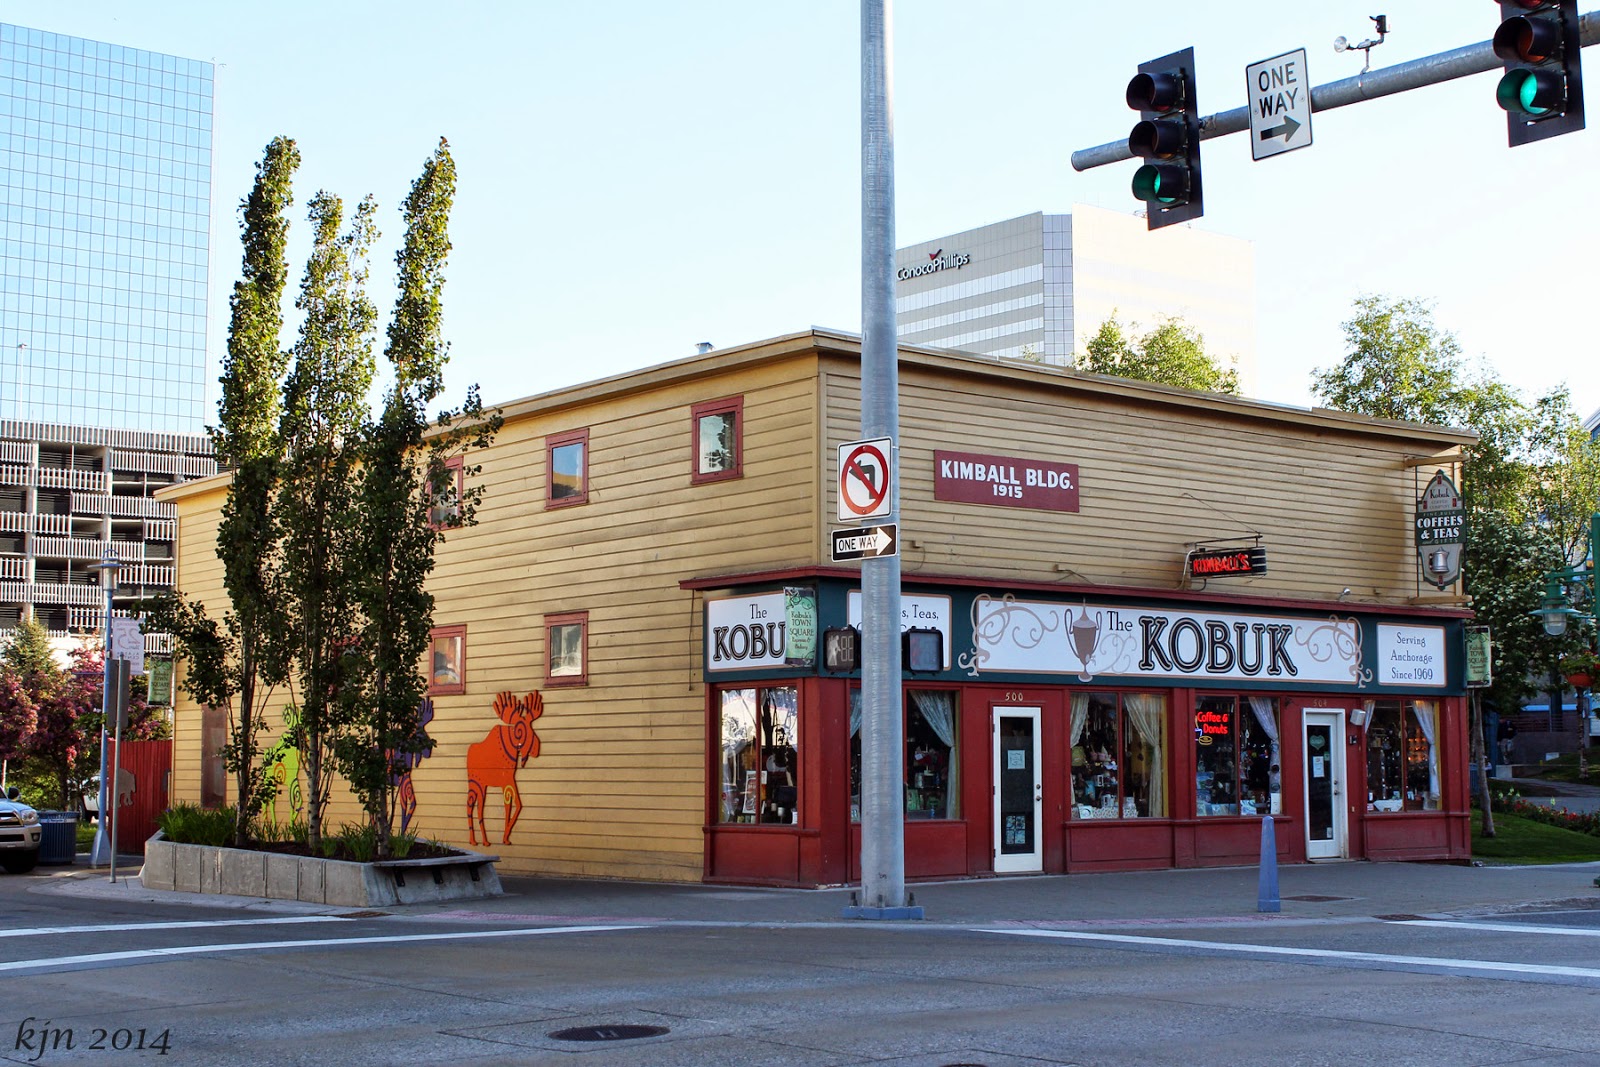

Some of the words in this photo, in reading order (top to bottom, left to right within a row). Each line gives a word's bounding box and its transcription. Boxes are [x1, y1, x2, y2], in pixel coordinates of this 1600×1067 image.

[1258, 61, 1297, 92] ONE
[1259, 87, 1298, 119] WAY
[897, 253, 970, 281] ConocoPhillips
[941, 459, 1020, 485] KIMBALL
[1026, 468, 1074, 490] BLDG.
[992, 484, 1023, 499] 1915
[1430, 488, 1450, 498] Kobuk
[1417, 516, 1464, 528] COFFEES
[1421, 530, 1430, 539] &
[1433, 527, 1460, 538] TEAS
[838, 538, 857, 552] ONE
[859, 535, 879, 549] WAY
[749, 603, 768, 619] The
[911, 604, 939, 620] Teas,
[791, 618, 812, 627] TOWN
[789, 628, 815, 637] SQUARE
[1396, 632, 1426, 647] Serving
[713, 621, 786, 662] KOBU
[1107, 610, 1133, 632] The
[1138, 615, 1299, 677] KOBUK
[1390, 649, 1433, 665] Anchorage
[1391, 667, 1413, 679] Since
[1414, 668, 1433, 680] 1969
[1005, 692, 1024, 701] 500
[1197, 711, 1221, 722] Coffee
[1203, 723, 1229, 734] Donuts
